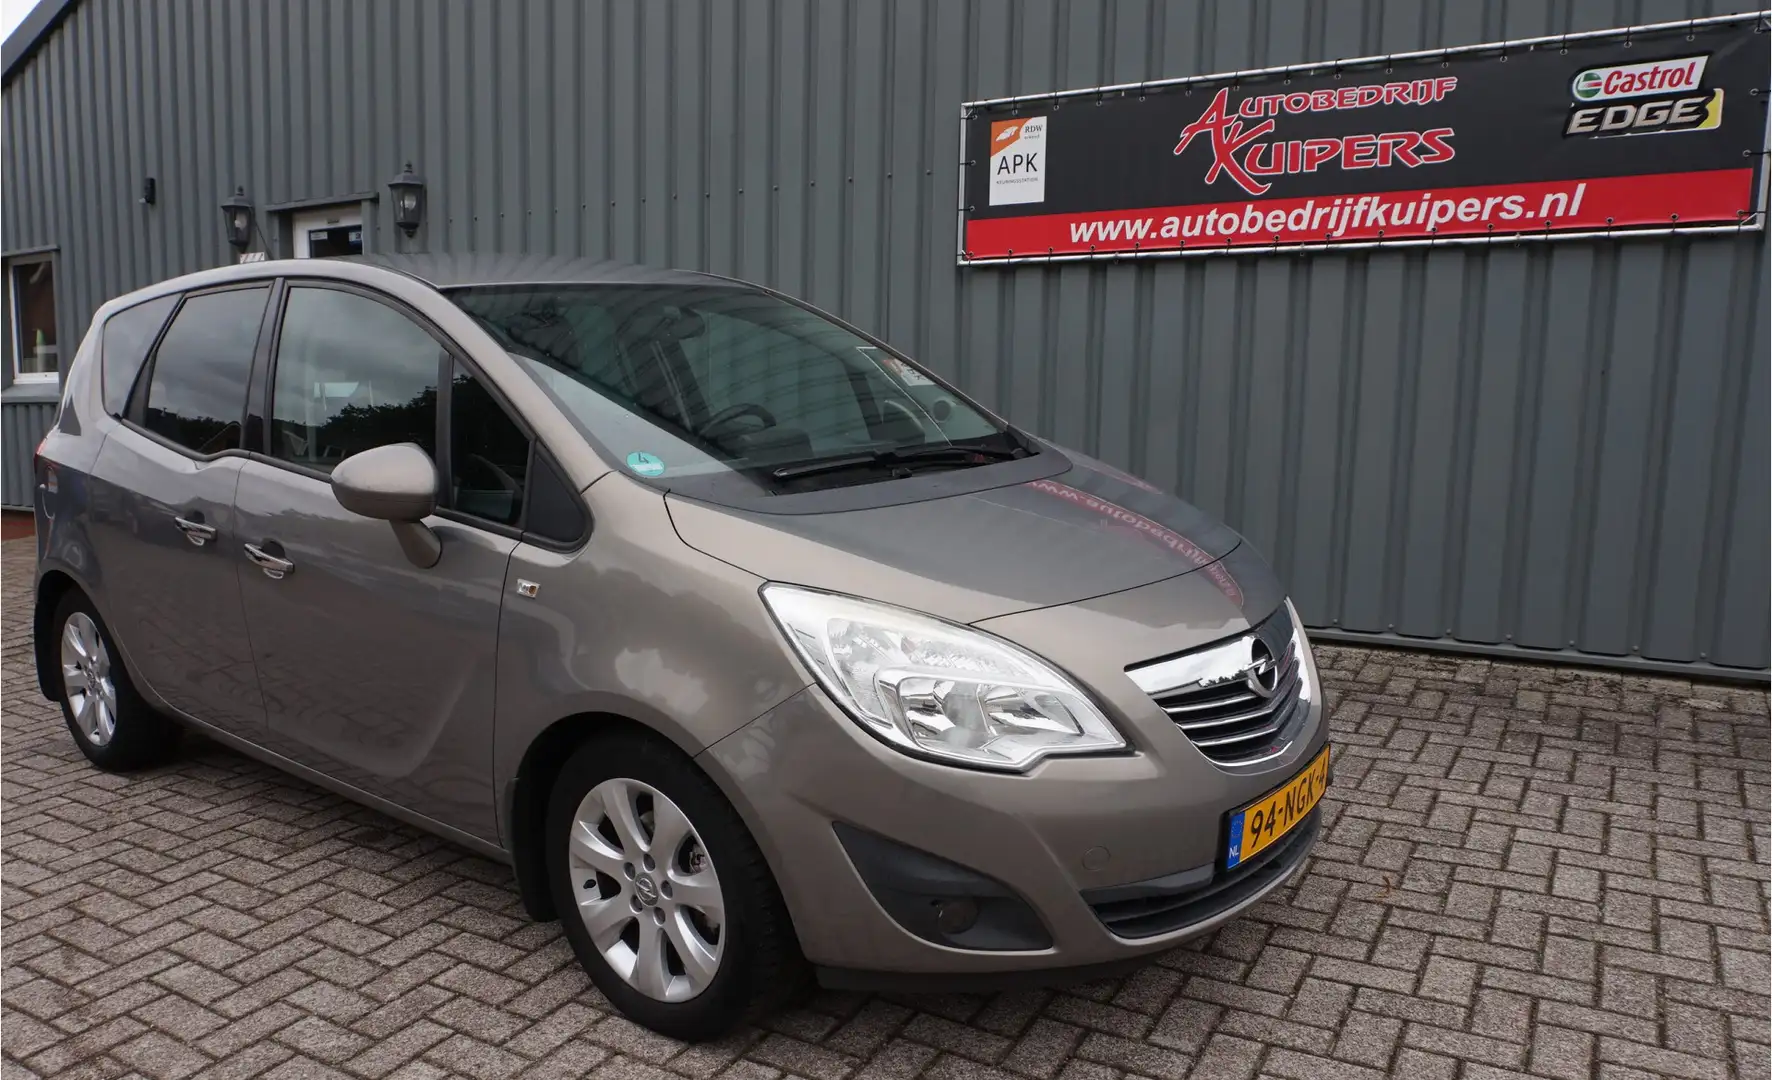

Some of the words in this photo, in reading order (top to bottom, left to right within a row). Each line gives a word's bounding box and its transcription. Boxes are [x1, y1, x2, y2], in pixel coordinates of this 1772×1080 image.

[1604, 62, 1696, 95] Castrol
[1024, 124, 1043, 134] RDW
[1566, 96, 1711, 135] EDGE
[997, 152, 1038, 175] APK
[1204, 119, 1456, 195] KUIPERS
[1070, 183, 1587, 243] www.autobedrijfkuipers.nl
[1251, 757, 1326, 849] 94-NGK-4
[1229, 845, 1240, 859] NL
